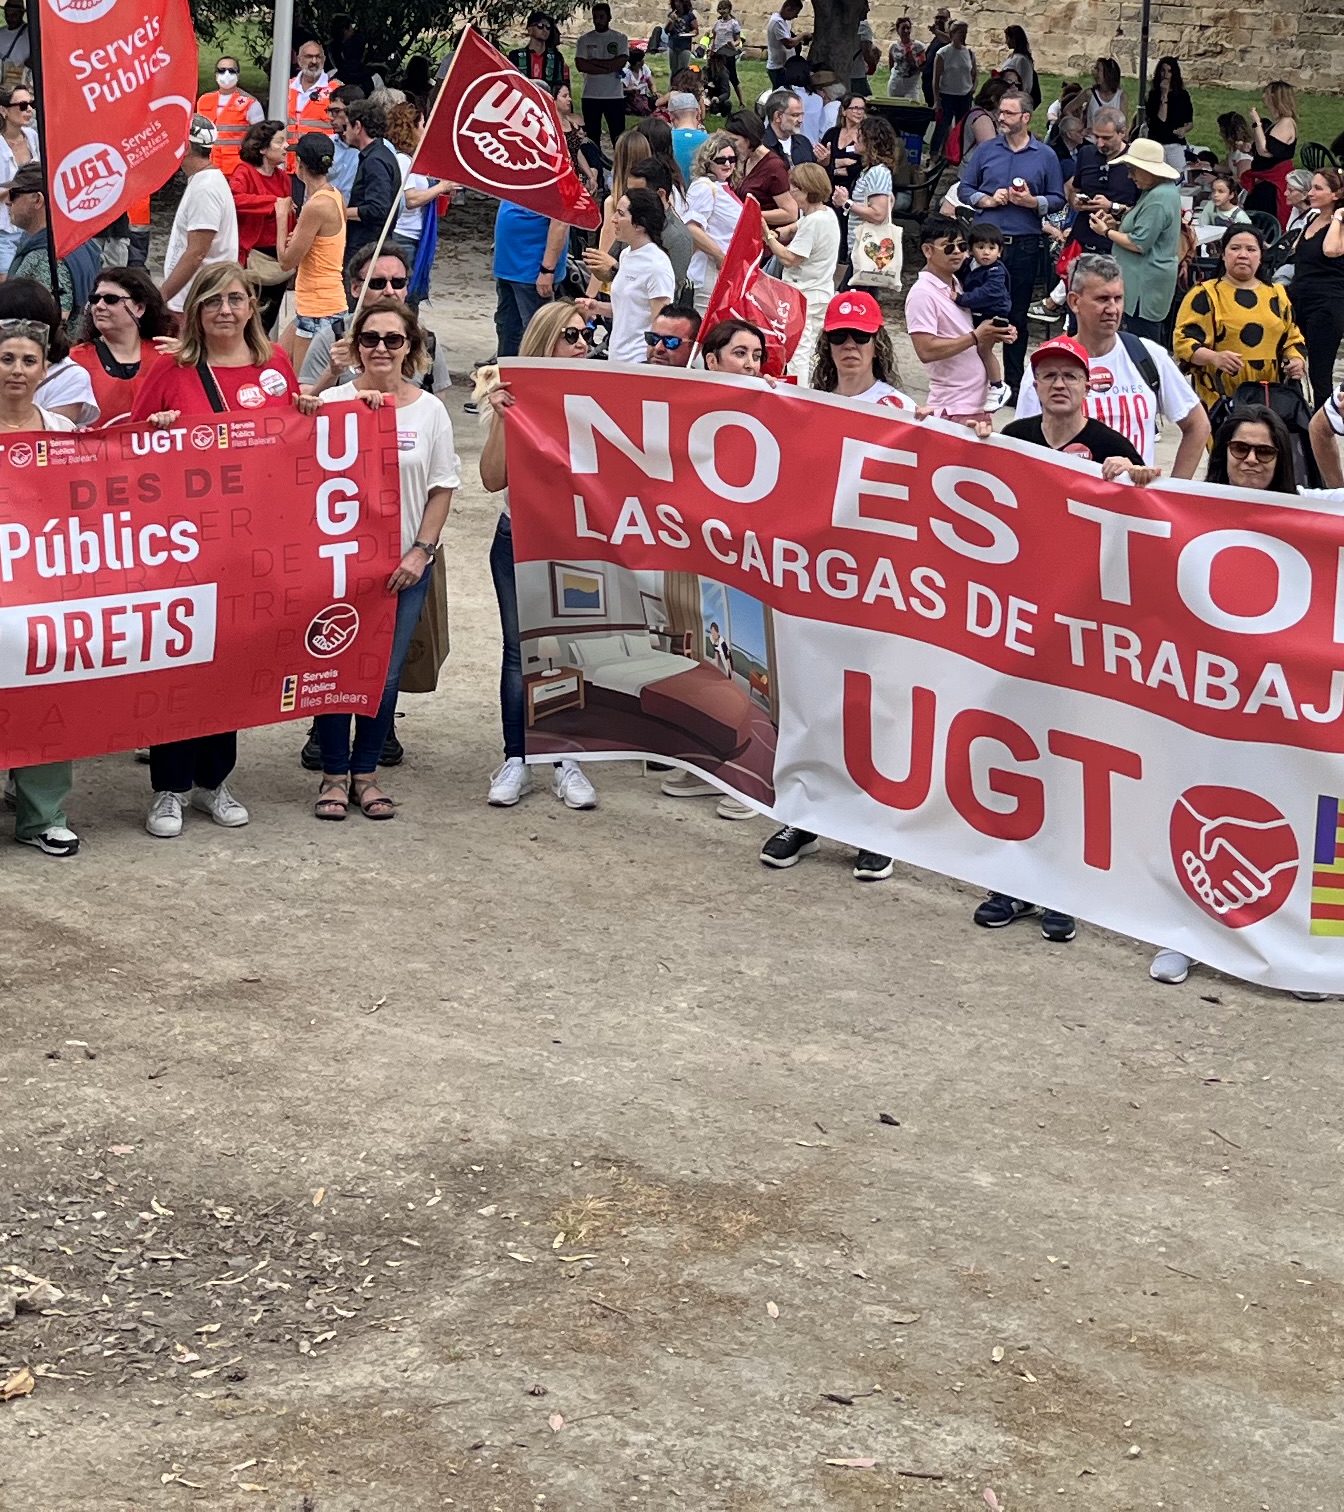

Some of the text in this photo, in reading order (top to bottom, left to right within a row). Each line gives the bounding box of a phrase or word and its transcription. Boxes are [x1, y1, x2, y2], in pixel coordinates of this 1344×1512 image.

[69, 14, 160, 81] Serveis
[81, 45, 171, 113] Públics
[121, 119, 162, 152] Serveis
[473, 80, 559, 157] UGT
[60, 148, 116, 196] UGT
[132, 428, 187, 455] UGT
[230, 422, 255, 431] Serveis
[230, 430, 255, 439] Públics
[248, 436, 276, 447] Balears
[69, 464, 244, 511] DES DE
[563, 393, 781, 504] NO
[831, 436, 1020, 565] ES
[316, 413, 359, 599] UGT
[573, 493, 691, 549] LAS
[702, 518, 947, 621] CARGAS
[966, 580, 1038, 657] DE
[24, 598, 195, 677] DRETS
[301, 681, 336, 695] Públics
[302, 669, 338, 683] Serveis
[300, 692, 368, 708] Illes Balears
[842, 669, 1142, 872] UGT
